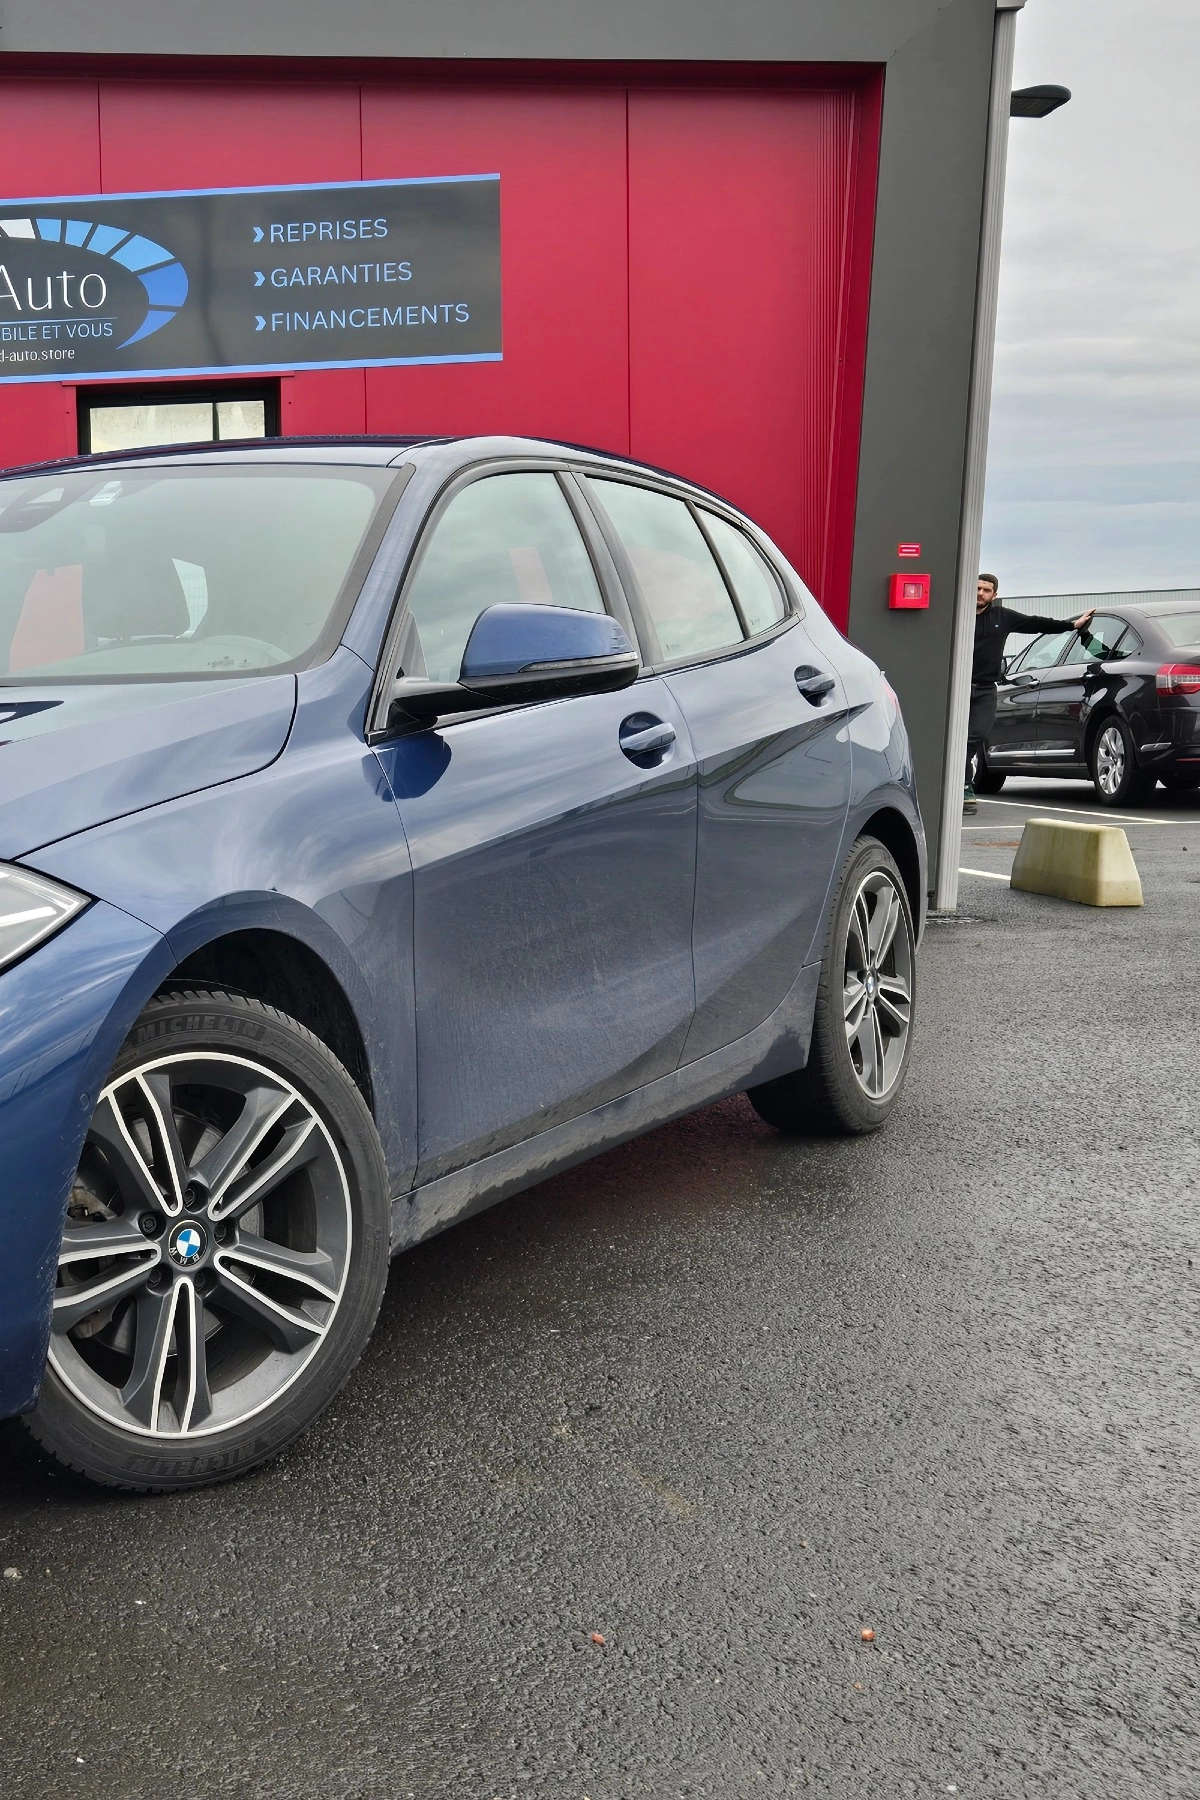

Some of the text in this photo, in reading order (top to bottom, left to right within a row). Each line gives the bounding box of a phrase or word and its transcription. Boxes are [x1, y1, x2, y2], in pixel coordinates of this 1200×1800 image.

[270, 218, 388, 243] REPRISES
[270, 261, 413, 288] GARANTIES
[42, 325, 61, 339] ET
[65, 322, 113, 338] VOUS
[271, 303, 470, 332] FINANCEMENTS
[137, 1014, 264, 1043] MICHELIN
[170, 1246, 200, 1265] BMW
